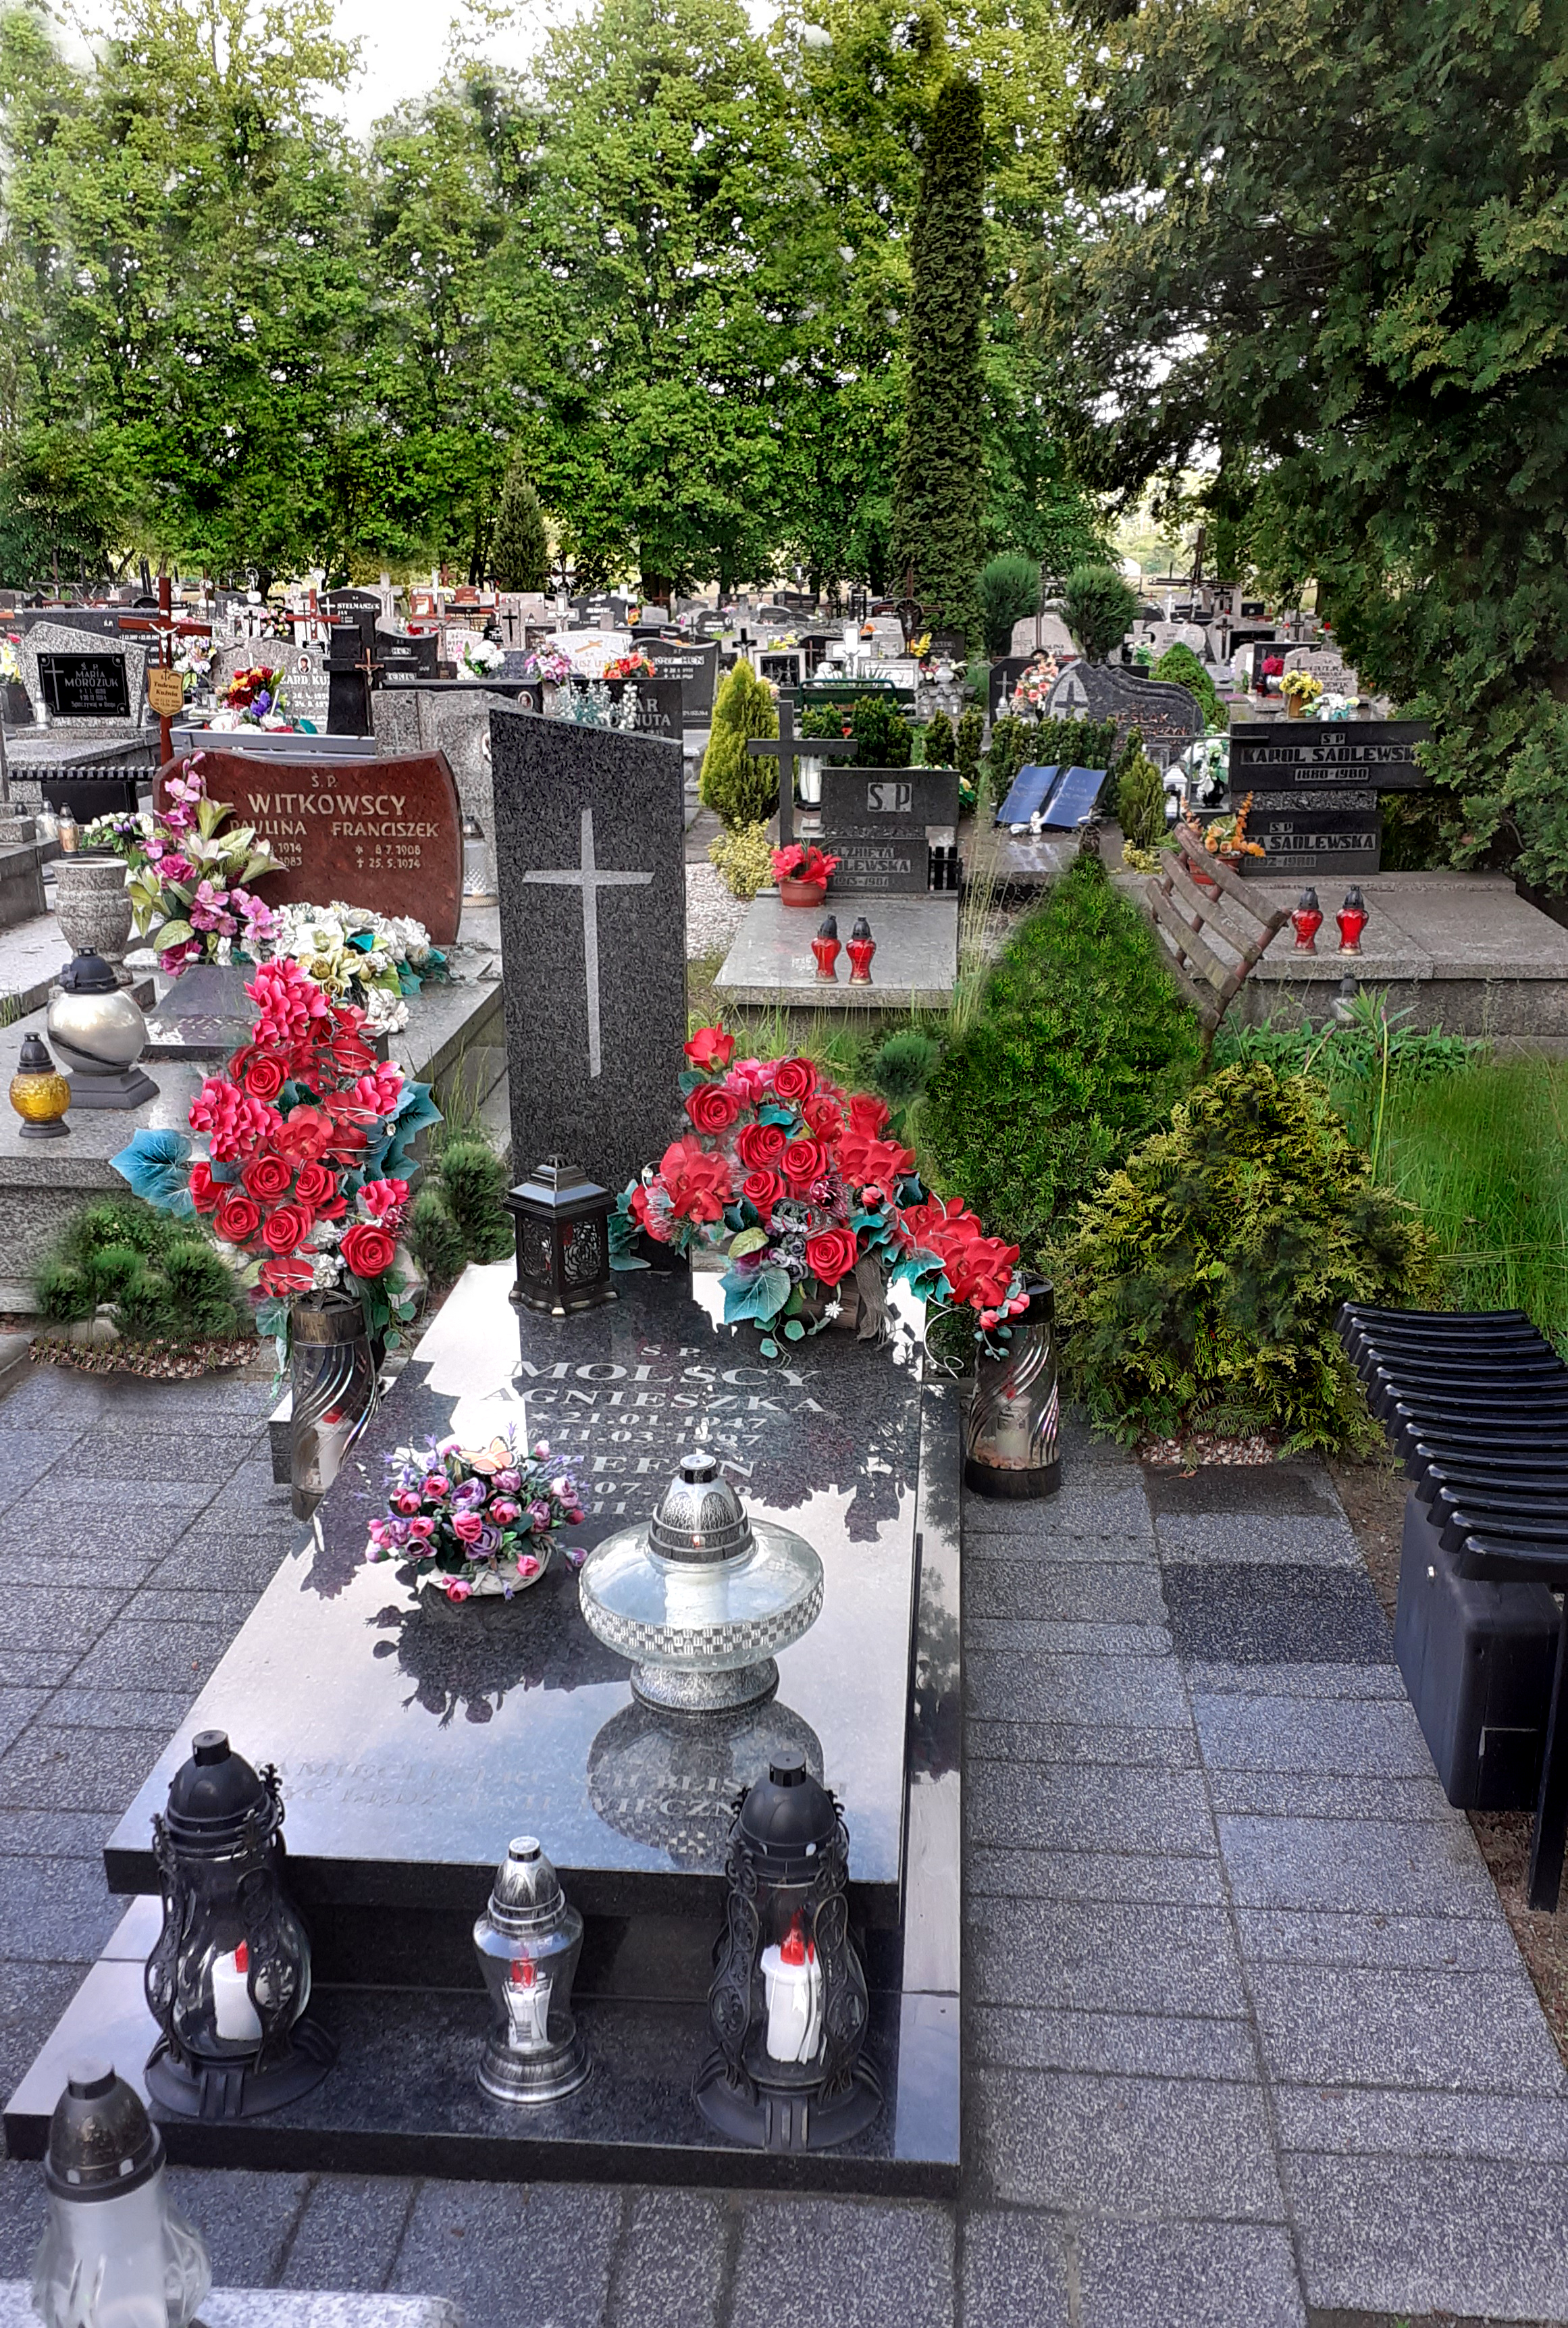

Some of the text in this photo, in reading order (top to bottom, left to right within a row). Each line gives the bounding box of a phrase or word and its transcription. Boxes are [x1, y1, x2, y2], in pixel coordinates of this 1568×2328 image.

[64, 677, 118, 687] MOROZIUK
[76, 670, 105, 678] MARIA
[1244, 746, 1417, 762] KAROL SADLEWSK
[247, 793, 406, 816] WITKOWSCY
[230, 819, 440, 838] PAULINA FRANCISZEK
[1270, 835, 1374, 850] SADLEWSKA
[837, 859, 909, 871] ILEWSKA
[504, 1360, 823, 1387] MOLSCY
[480, 1387, 827, 1413] AGNIESZKA
